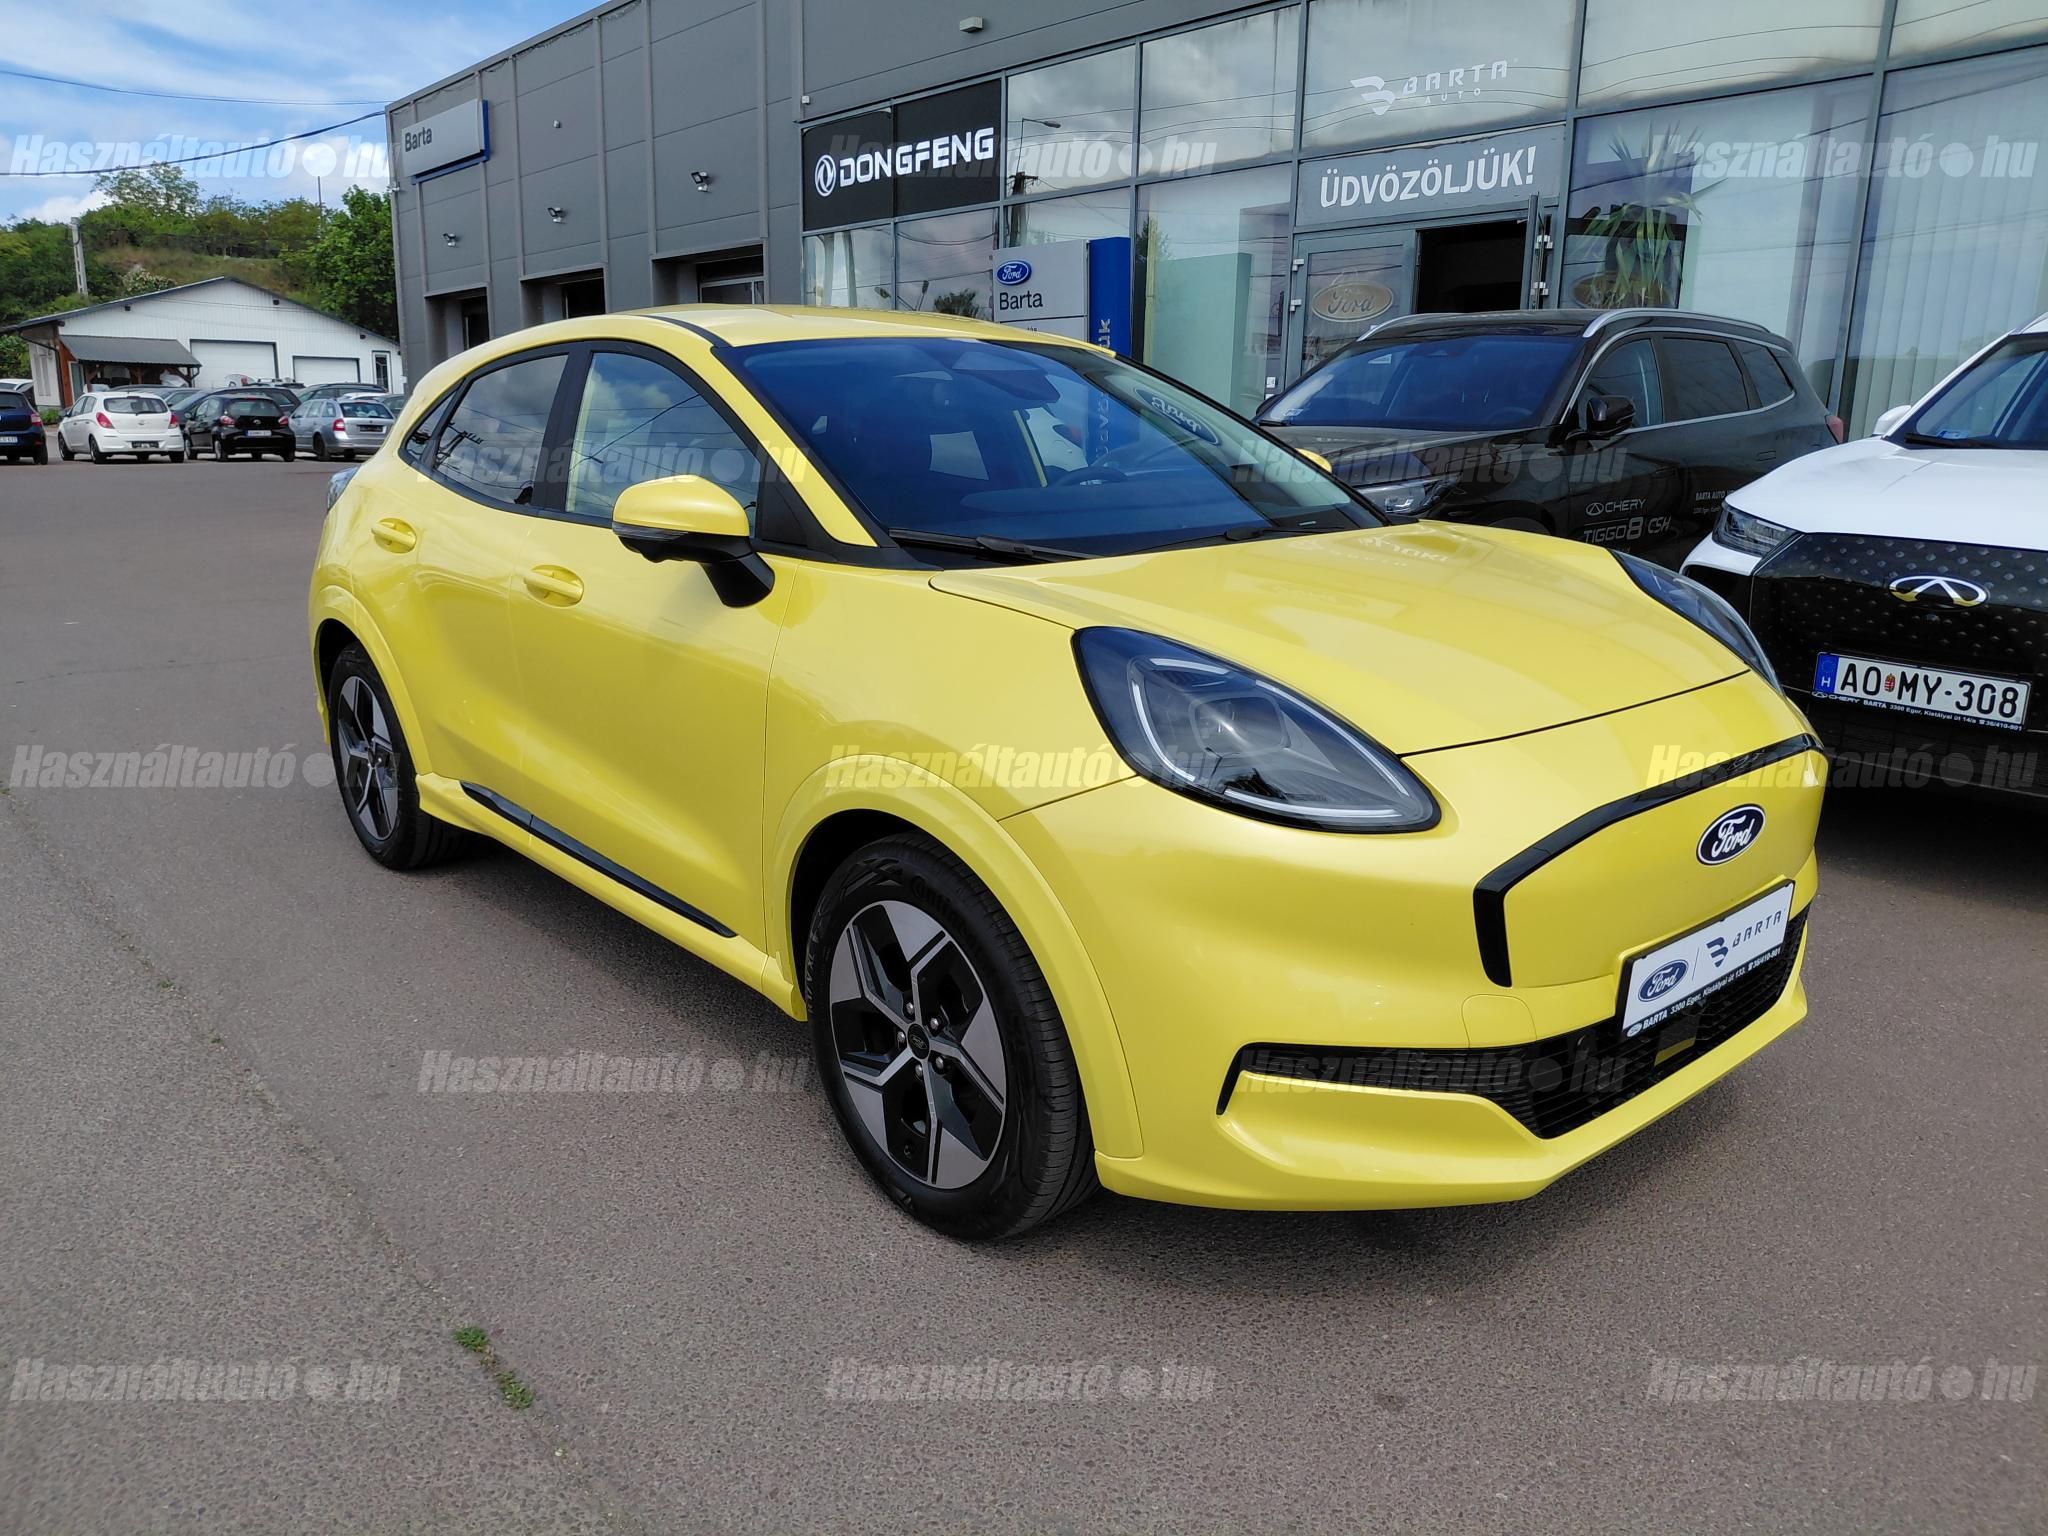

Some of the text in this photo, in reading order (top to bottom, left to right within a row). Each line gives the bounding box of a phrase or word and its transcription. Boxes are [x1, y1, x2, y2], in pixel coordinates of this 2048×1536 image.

[1402, 60, 1507, 95] BARTA
[1424, 87, 1481, 104] AUTO
[405, 127, 432, 152] Barta
[840, 127, 994, 187] DONGFENG
[1320, 146, 1537, 208] ÜDVÖZÖLJÜK!
[1000, 290, 1043, 311] Barta
[1605, 499, 1647, 513] CHERY
[1821, 677, 1831, 688] H
[1840, 663, 2019, 718] AO MY-308
[1863, 699, 1887, 709] BARTA
[1711, 815, 1756, 858] Ford
[1647, 910, 1782, 997] Ford BARTA
[1642, 1009, 1668, 1030] BARTA
